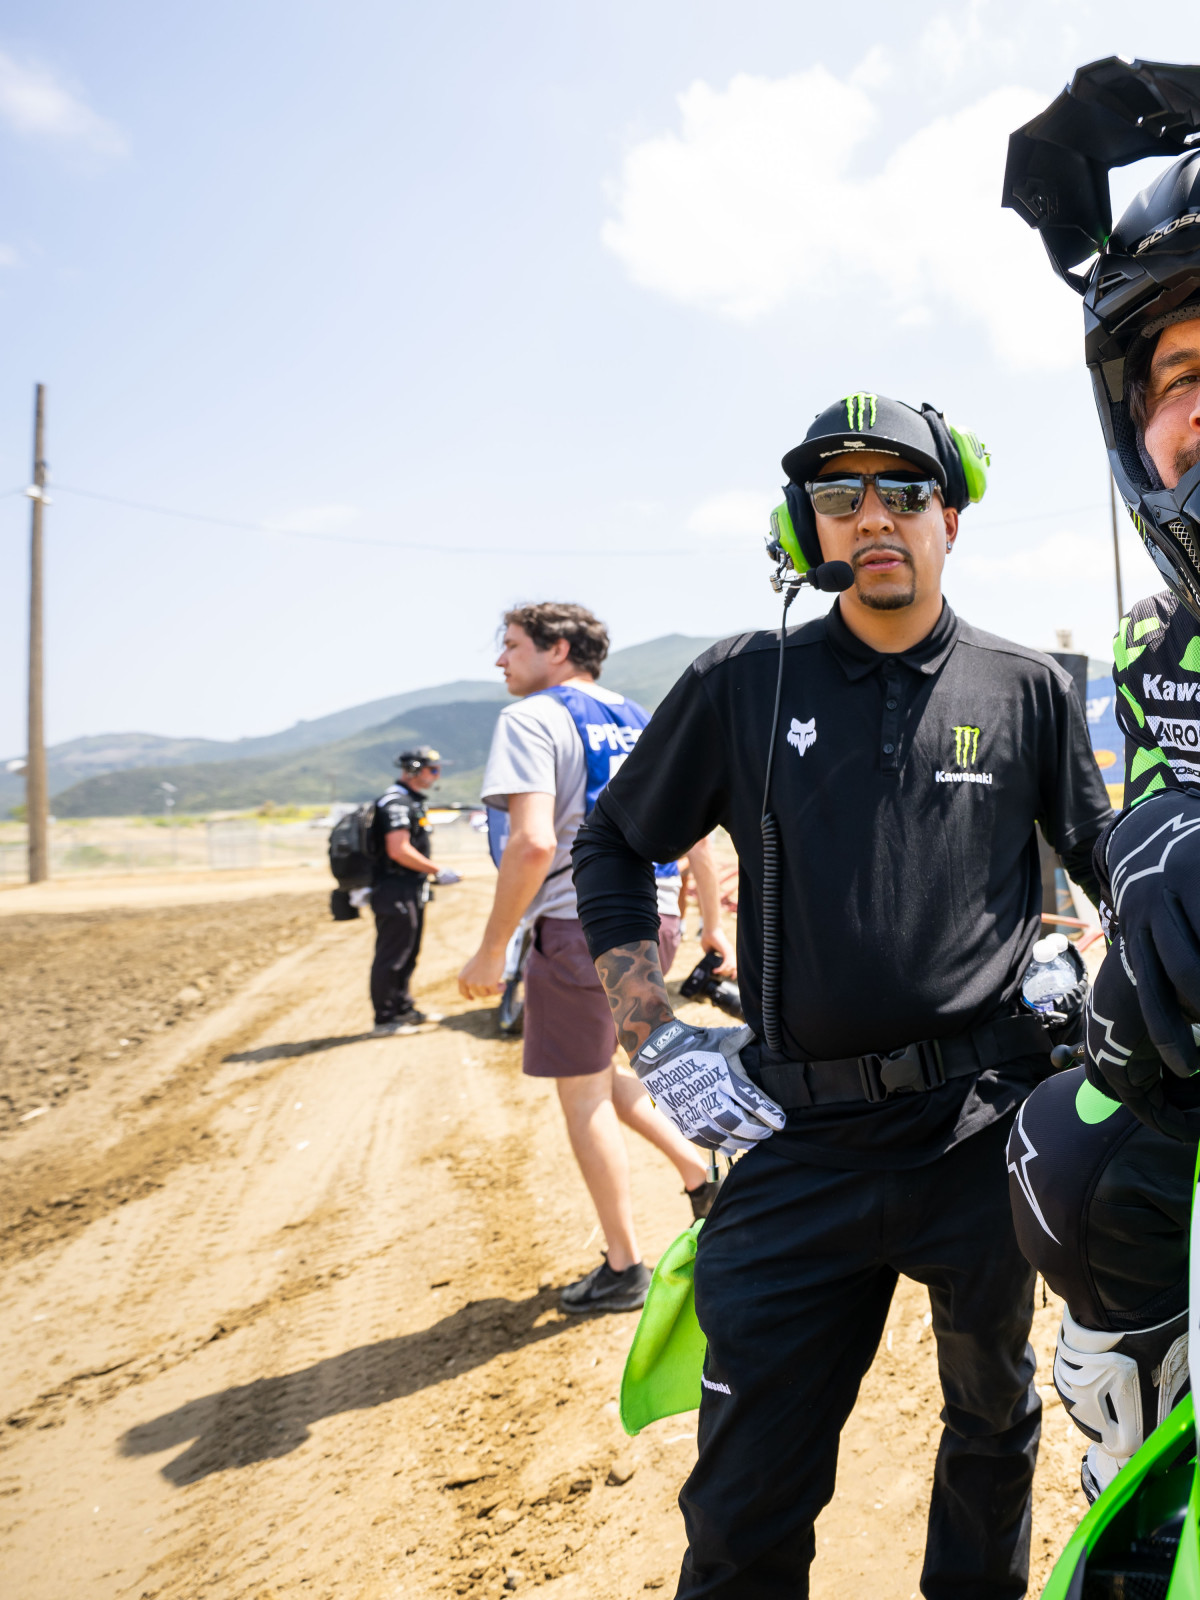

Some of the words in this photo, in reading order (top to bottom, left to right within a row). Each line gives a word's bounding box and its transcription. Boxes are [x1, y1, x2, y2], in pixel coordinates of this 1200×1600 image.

[935, 771, 993, 785] Kawasaki
[643, 1058, 701, 1098] Mechanix
[661, 1066, 724, 1112] Mechanix
